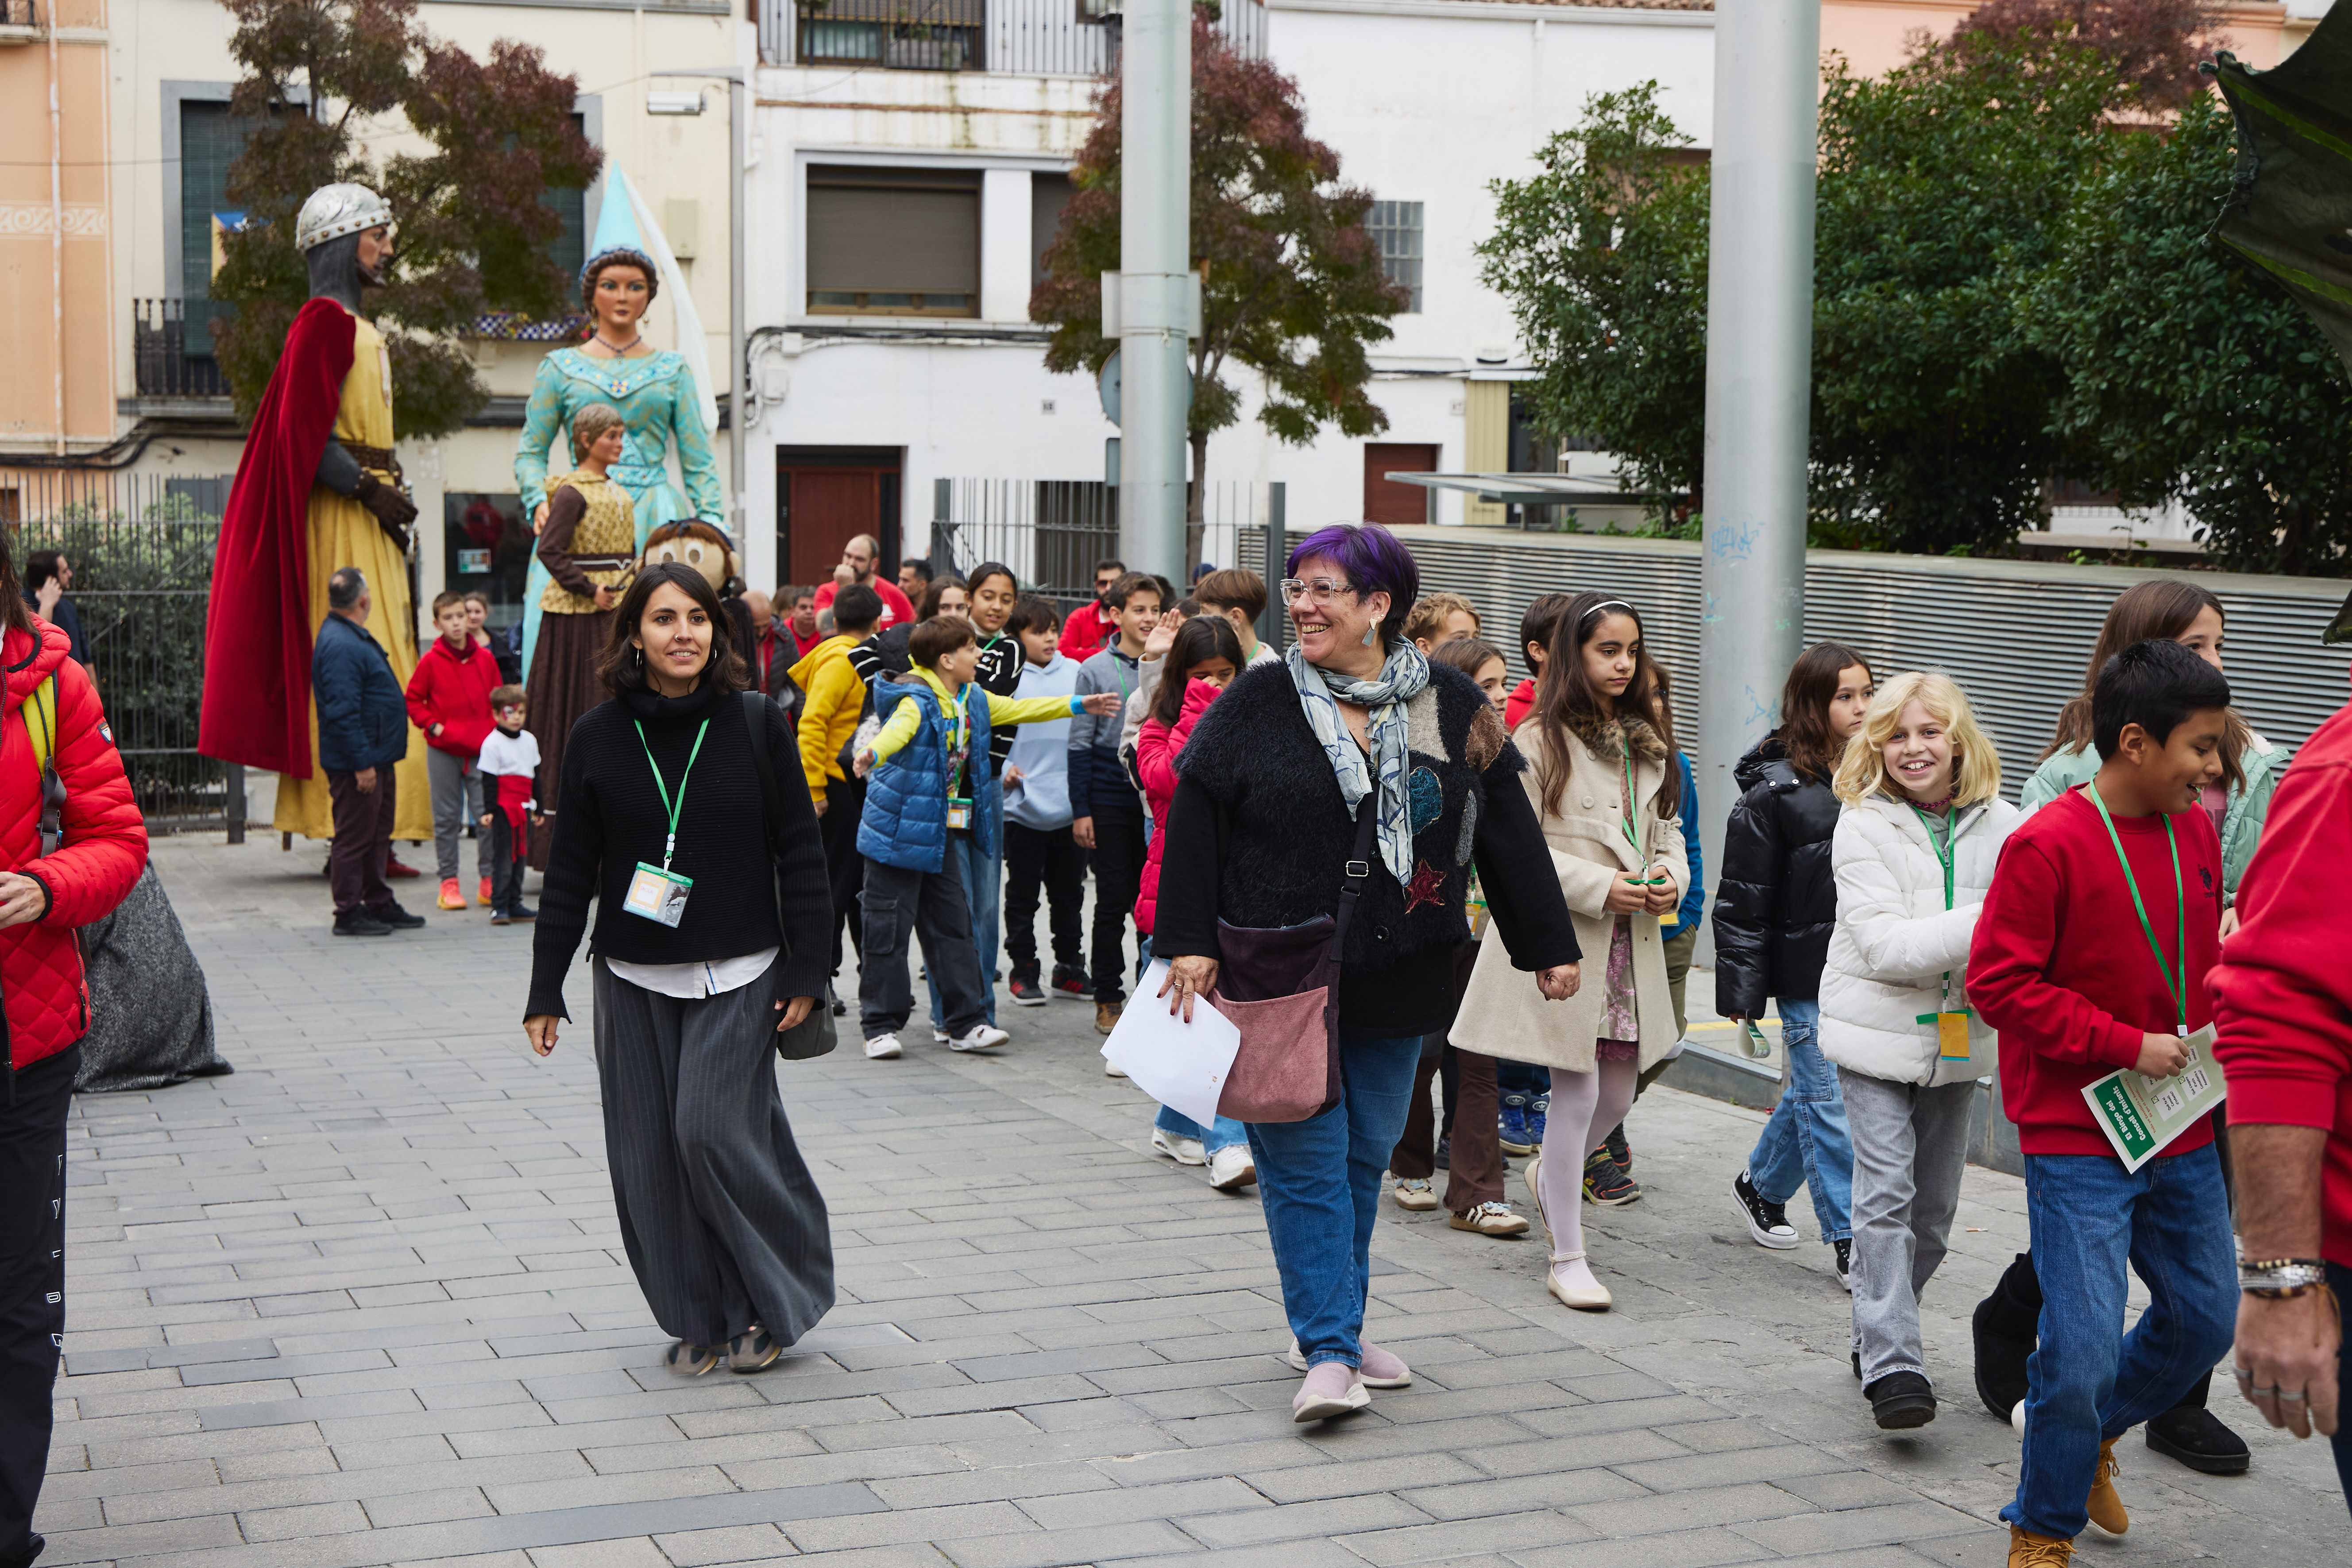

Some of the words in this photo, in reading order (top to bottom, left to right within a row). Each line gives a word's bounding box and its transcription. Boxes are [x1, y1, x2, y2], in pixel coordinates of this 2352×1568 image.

[640, 886, 653, 894] PAULA
[2185, 1076, 2194, 1089] s'espera
[2105, 1100, 2116, 1111] del
[2113, 1085, 2131, 1114] d'Infants
[2114, 1112, 2128, 1133] Bingo
[2128, 1115, 2146, 1140] Consell
[2124, 1132, 2132, 1140] El
